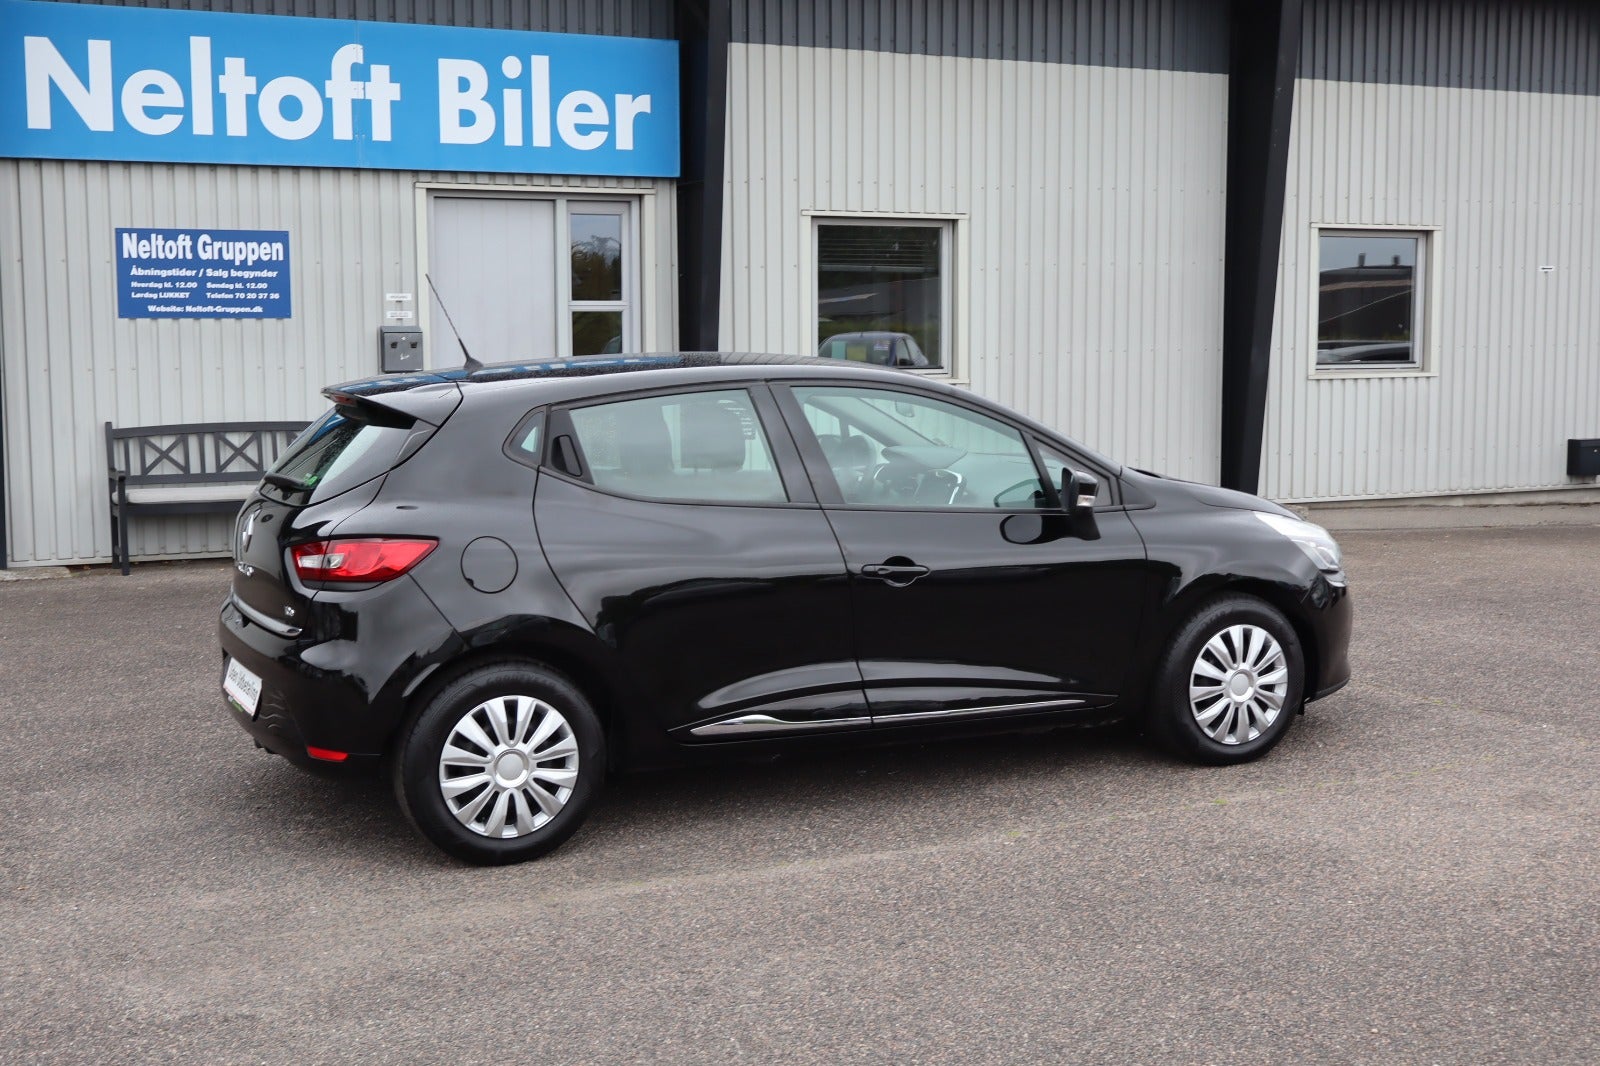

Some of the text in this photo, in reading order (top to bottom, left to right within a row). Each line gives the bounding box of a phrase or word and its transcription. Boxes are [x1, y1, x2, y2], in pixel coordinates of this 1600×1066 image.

[24, 35, 651, 151] Neltoft Biler
[122, 232, 284, 266] Neltoft Gruppen
[130, 265, 197, 277] Åbningstider
[206, 268, 228, 279] Salg
[230, 270, 278, 279] begynder
[148, 305, 263, 314] Website: Neltoft-Gruppen.dk
